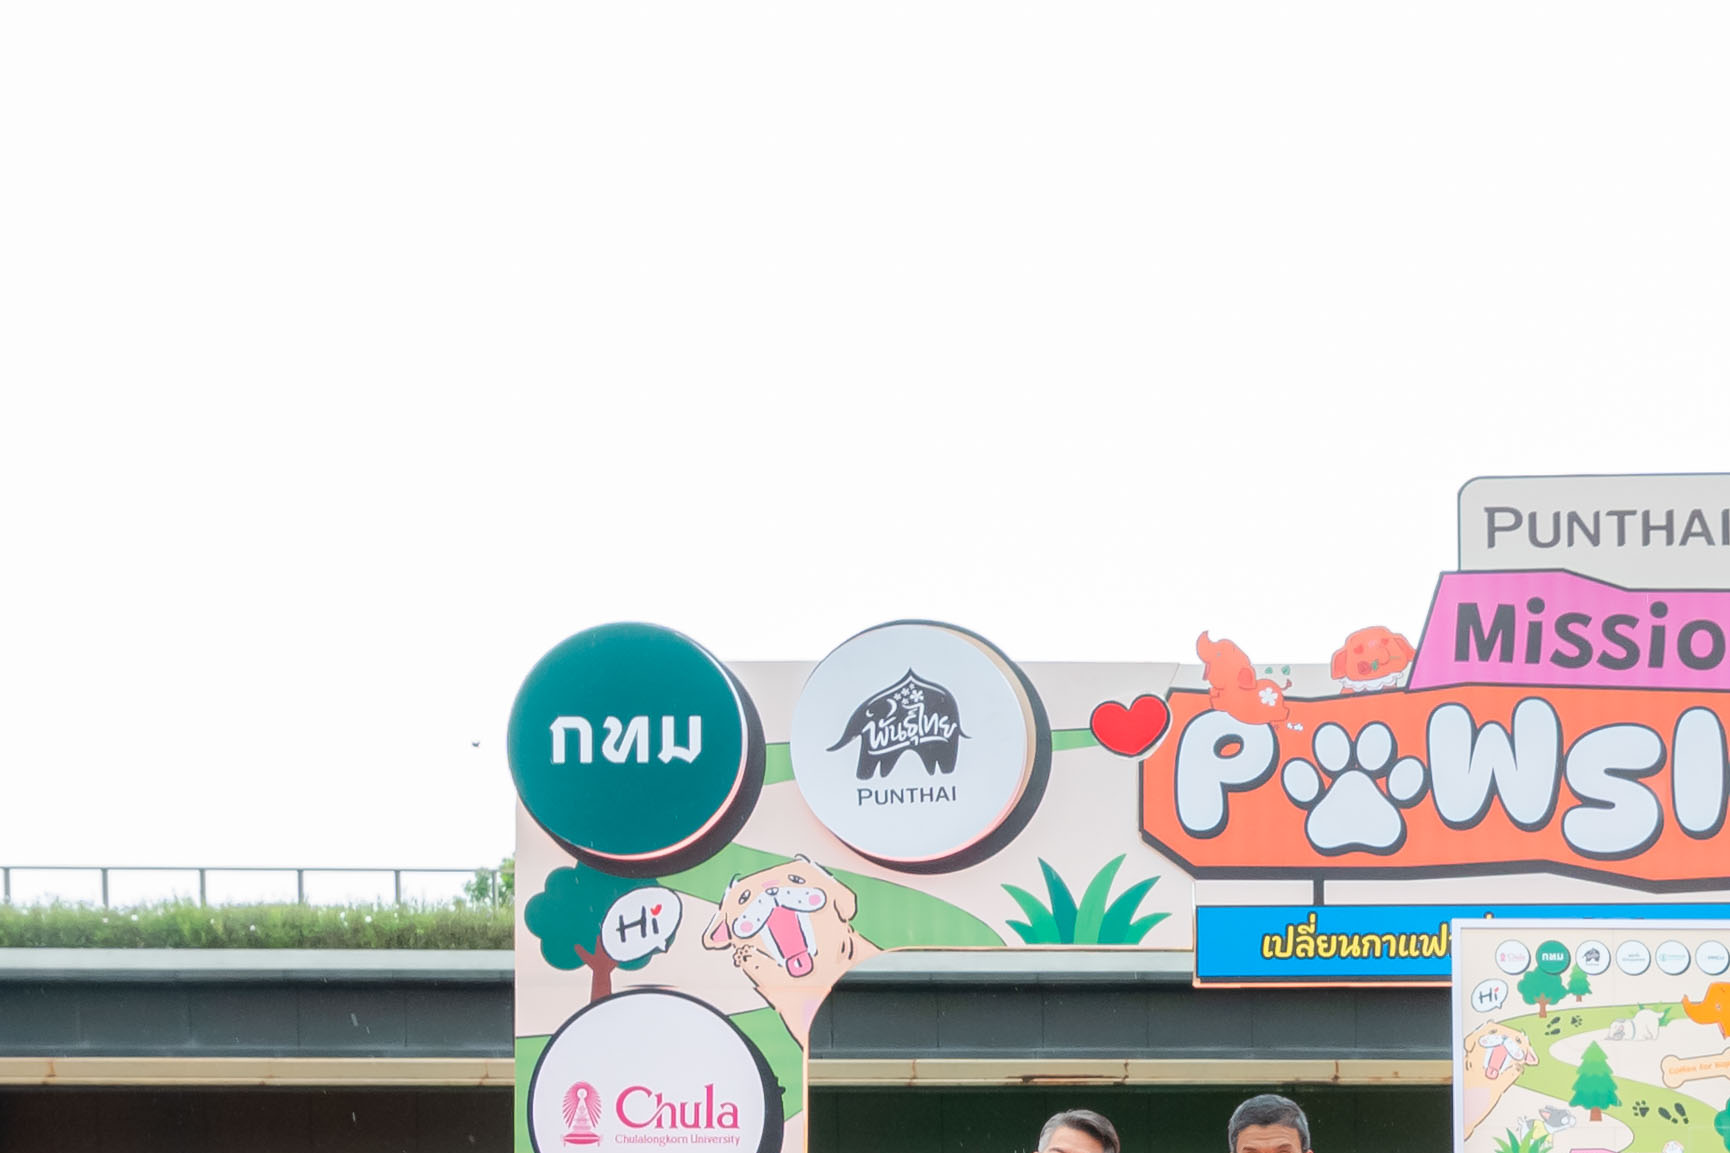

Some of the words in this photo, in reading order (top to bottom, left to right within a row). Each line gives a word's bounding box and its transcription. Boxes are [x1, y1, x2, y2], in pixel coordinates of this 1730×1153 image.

[1484, 506, 1730, 549] PUNTHAI
[549, 714, 702, 764] กทม
[857, 785, 957, 806] PUNTHAI
[616, 904, 662, 946] Hi
[1478, 987, 1499, 1004] Hi
[615, 1083, 740, 1129] Chula
[691, 1134, 740, 1147] University
